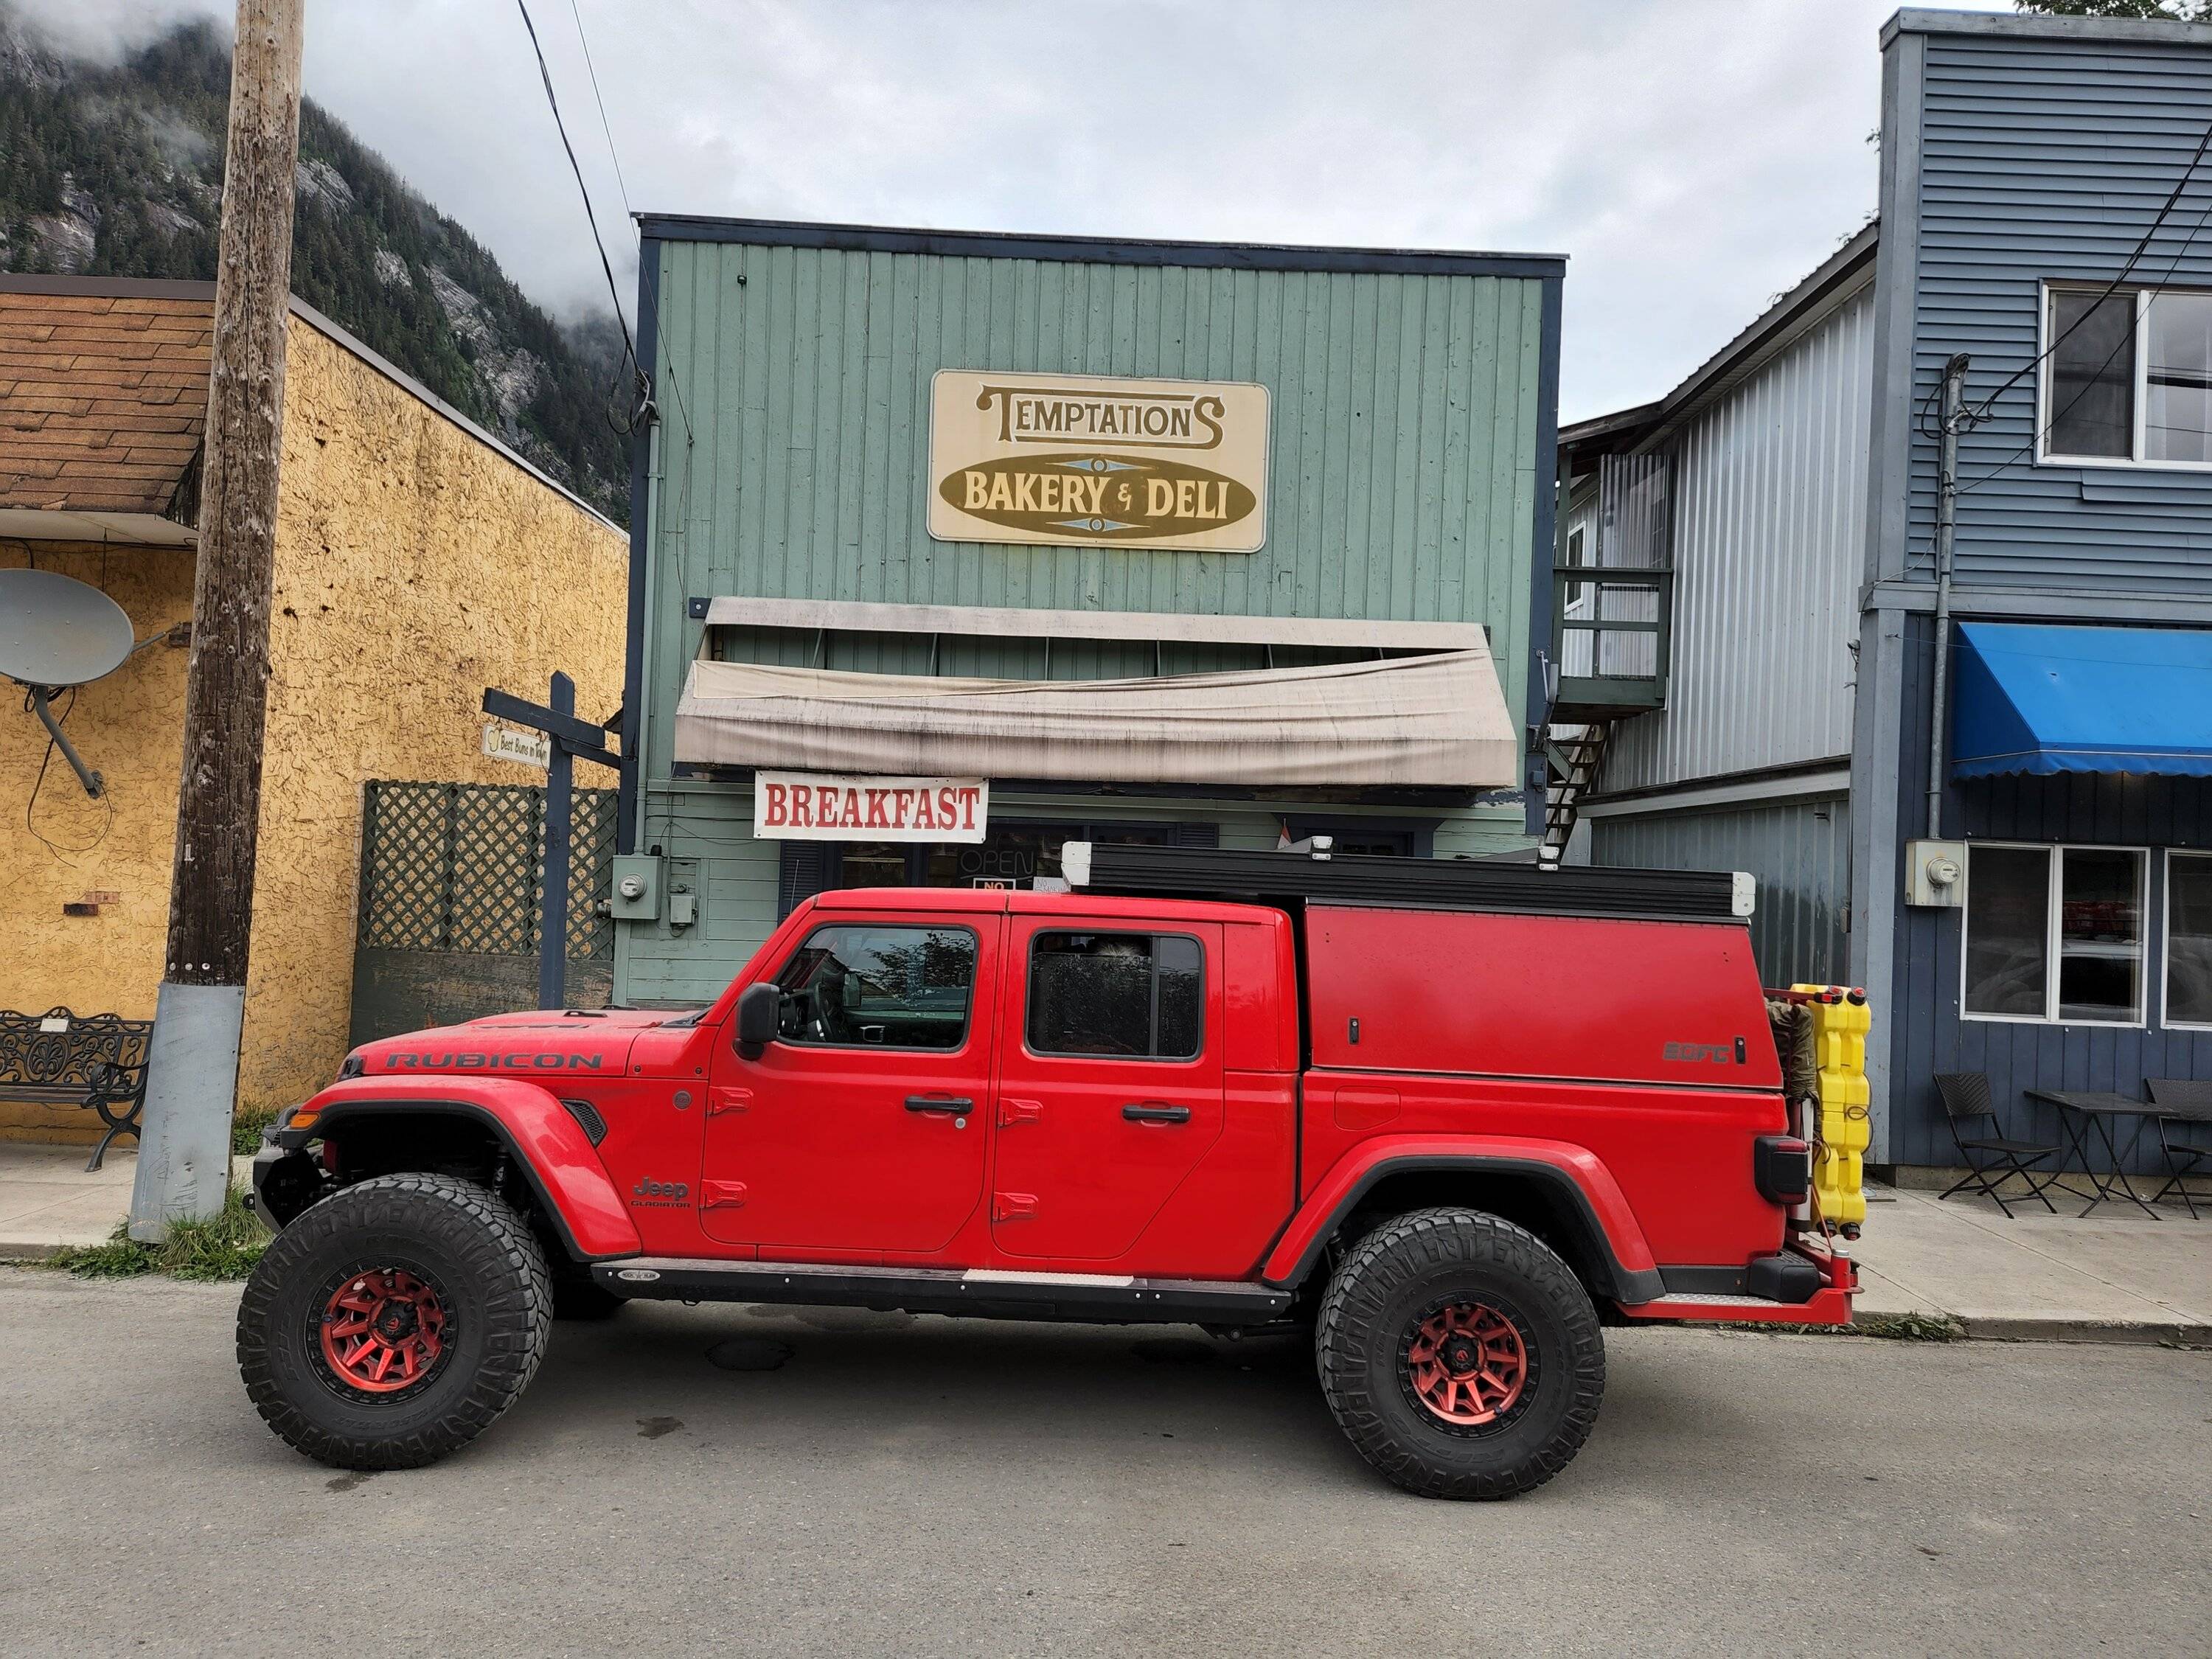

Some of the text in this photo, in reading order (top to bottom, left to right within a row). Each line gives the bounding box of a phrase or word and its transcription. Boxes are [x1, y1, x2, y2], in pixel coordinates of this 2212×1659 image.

[975, 383, 1226, 451] TEMPTATIONS
[963, 470, 1231, 520] BAKERY & DELI
[501, 734, 514, 751] Best
[515, 737, 529, 756] Buns
[764, 782, 981, 831] BREAKFAST
[960, 850, 1034, 874] OPEN
[984, 881, 1005, 890] NO
[385, 1052, 603, 1069] RUBICON
[633, 1175, 689, 1201] Jeep
[630, 1199, 691, 1208] GLADIATOR
